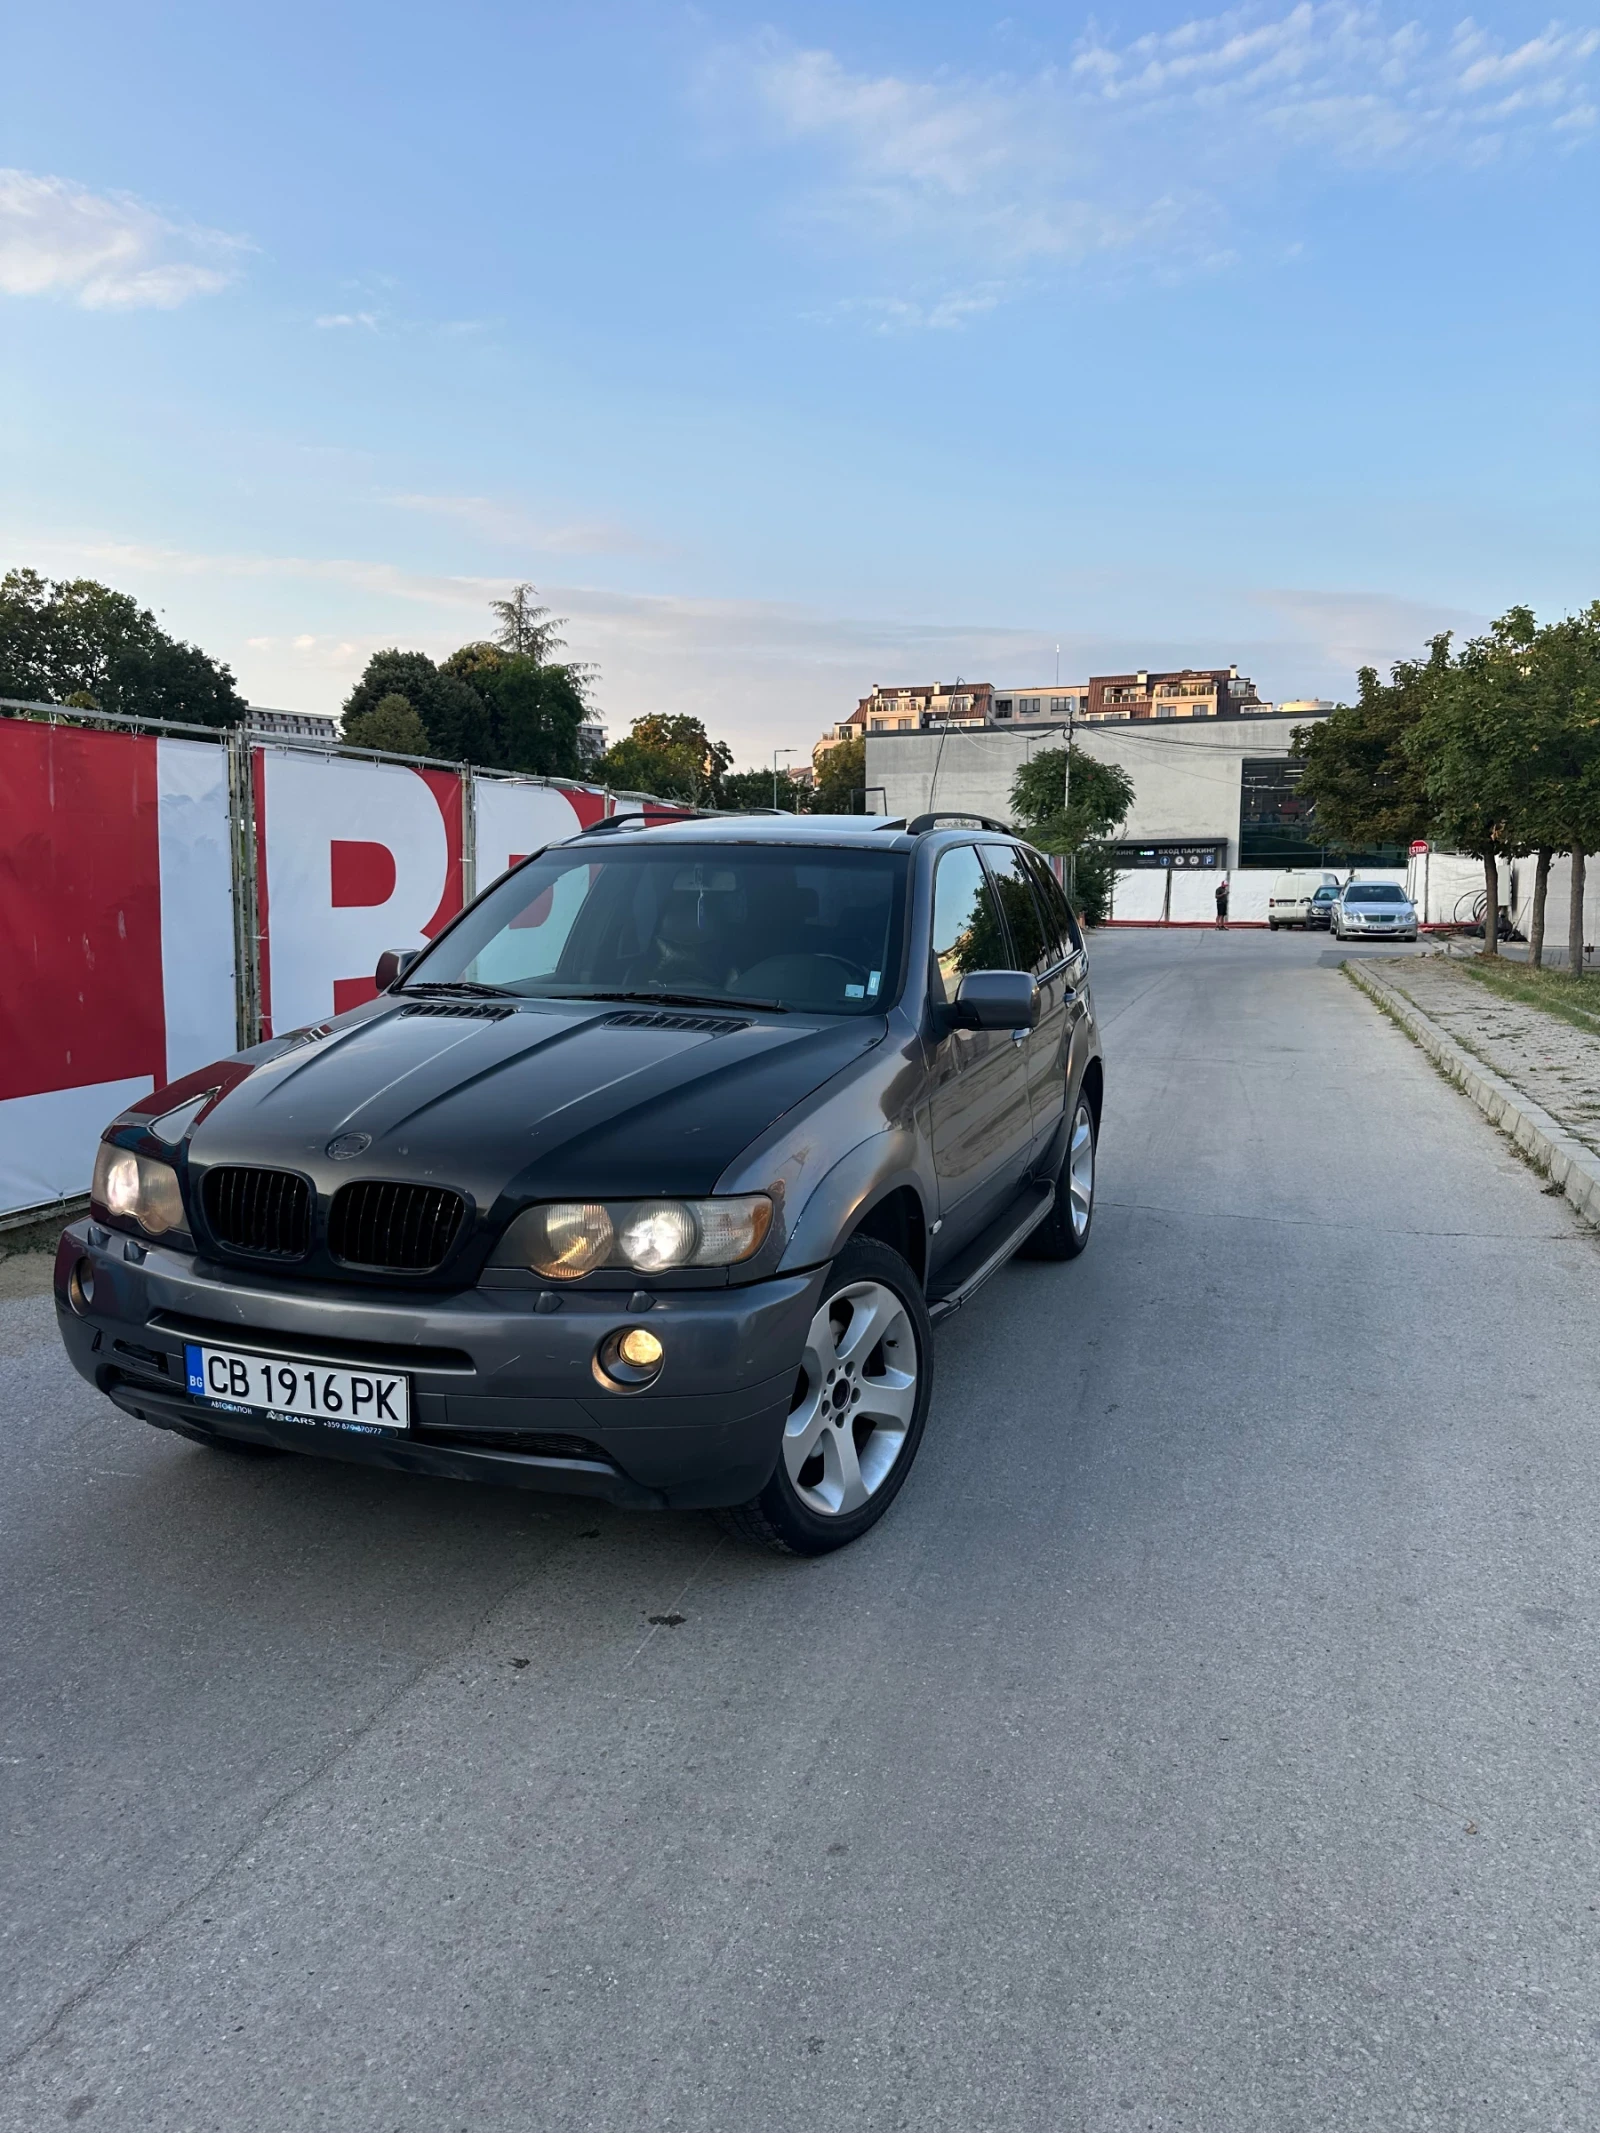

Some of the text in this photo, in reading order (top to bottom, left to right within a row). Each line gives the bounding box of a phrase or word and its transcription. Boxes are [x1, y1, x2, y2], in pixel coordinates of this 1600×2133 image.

[190, 1375, 203, 1388] BG
[208, 1355, 399, 1421] CB 1916 PK
